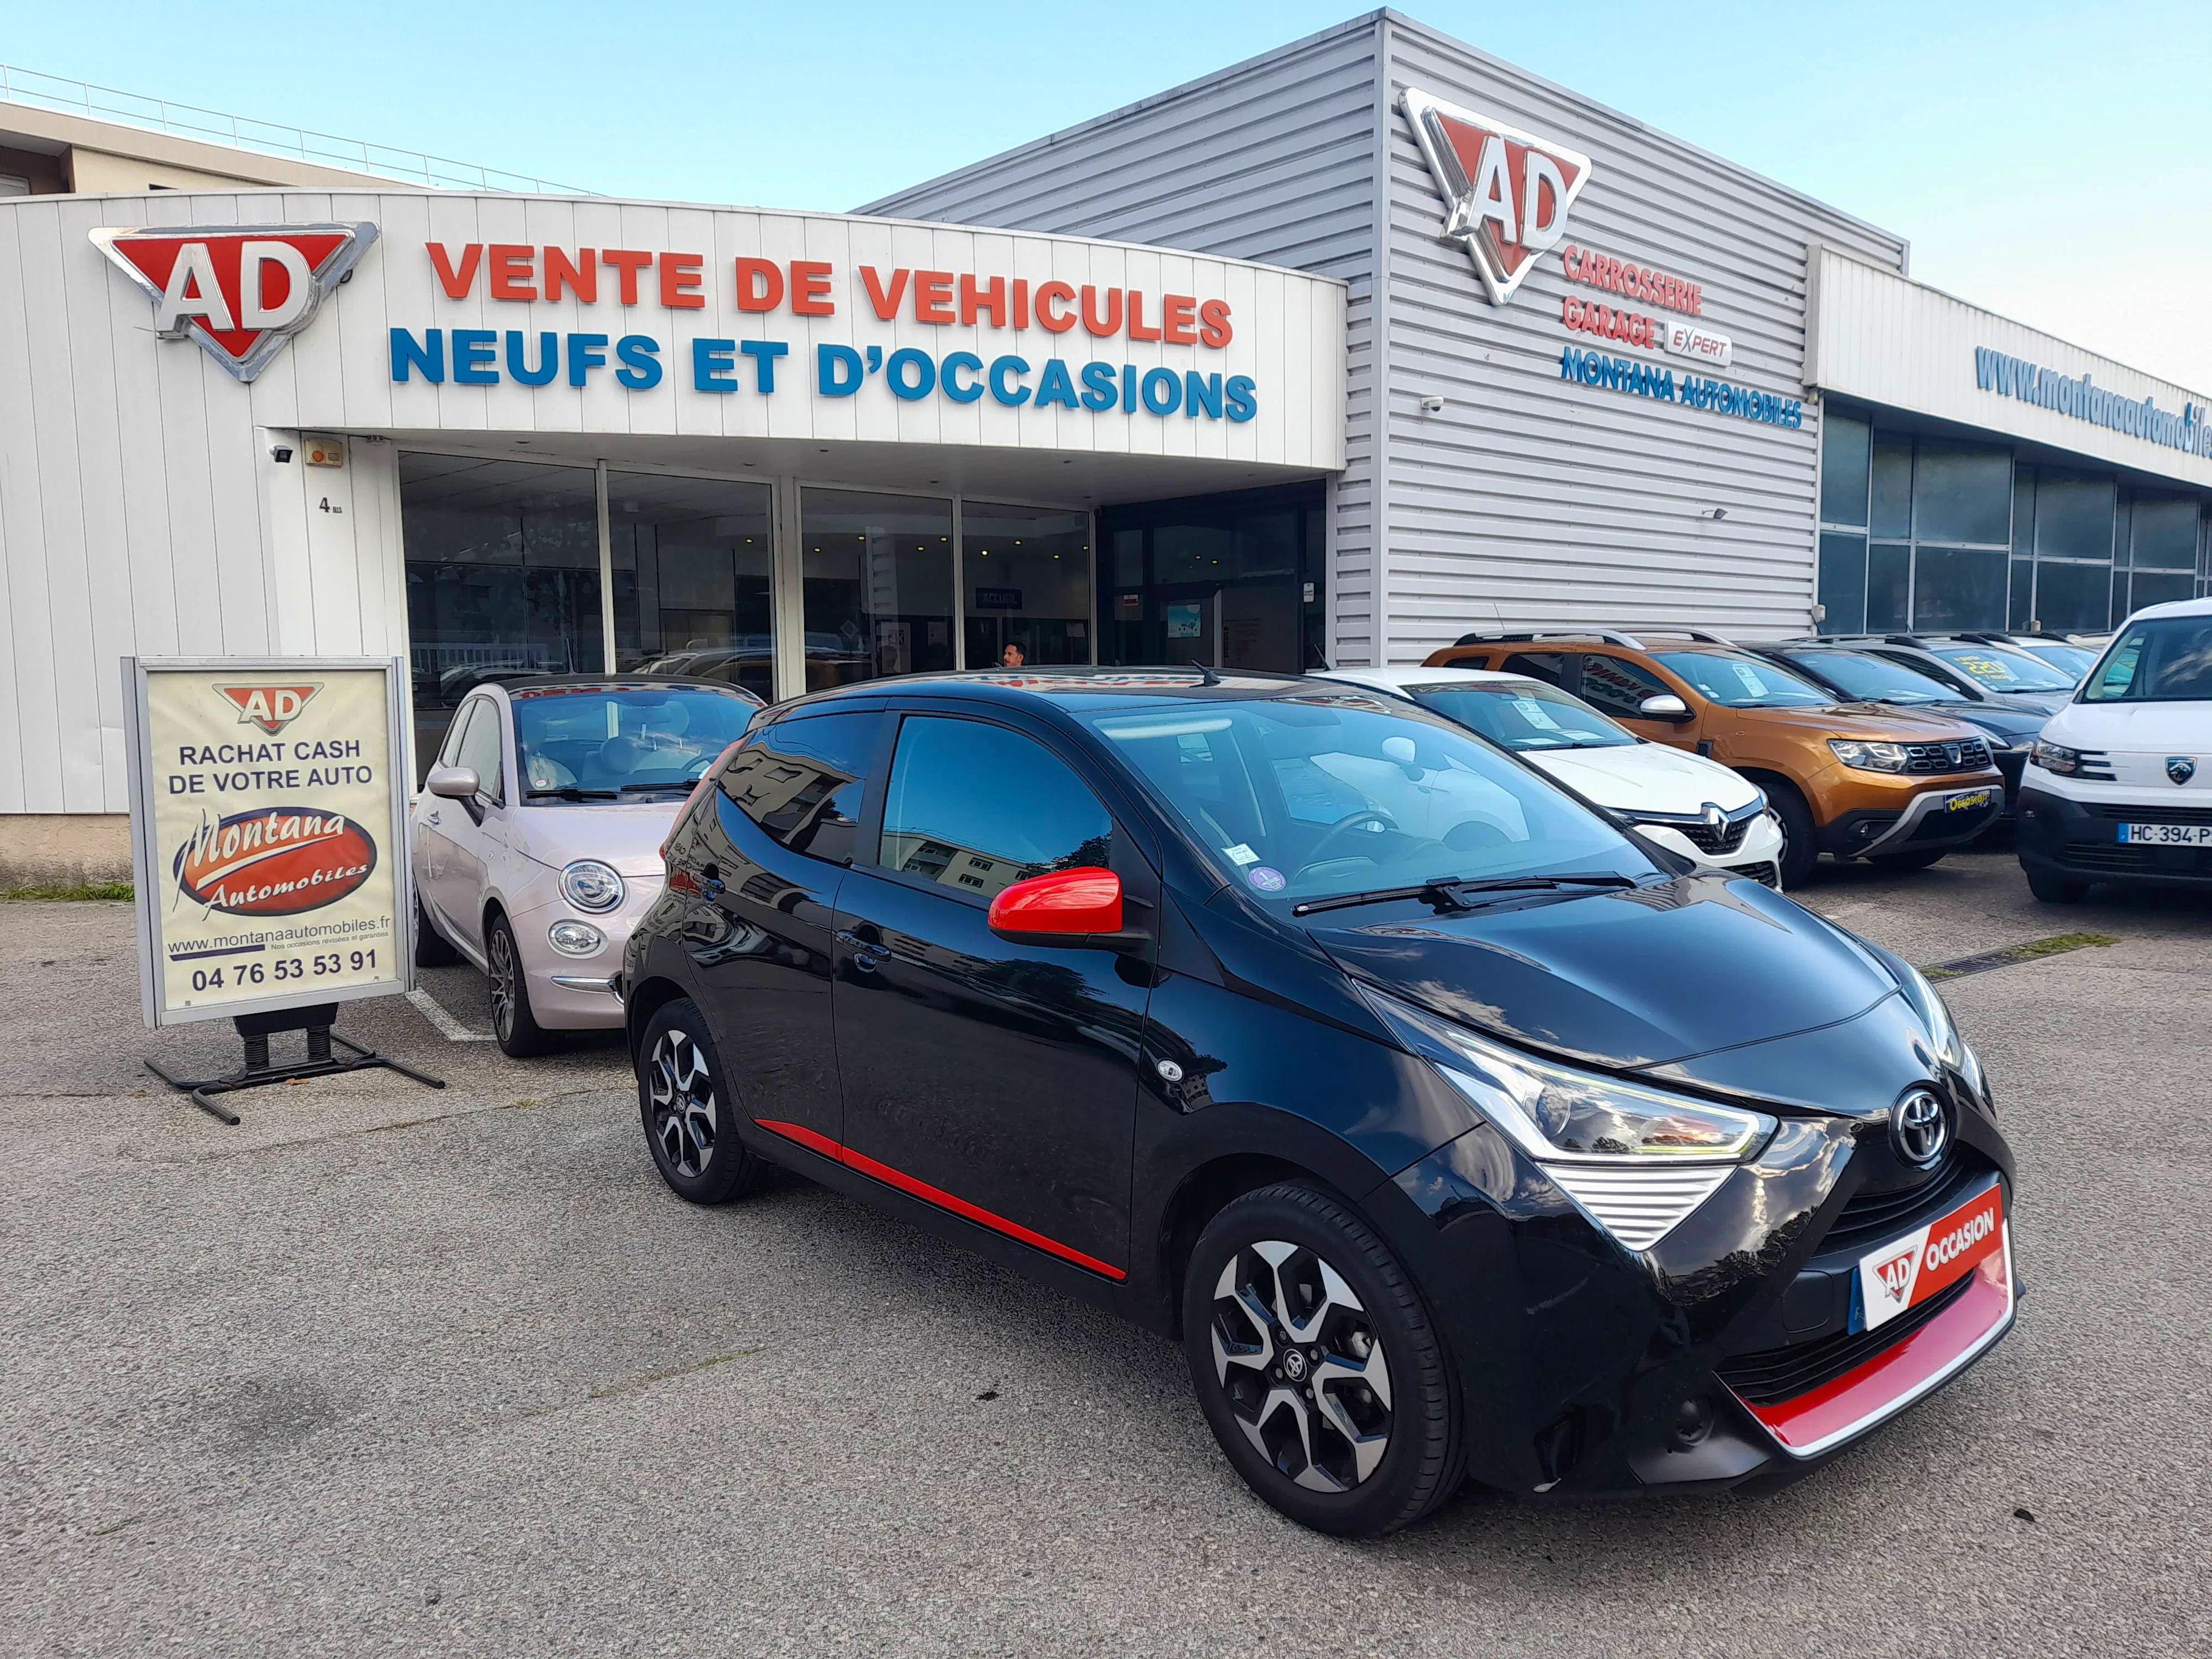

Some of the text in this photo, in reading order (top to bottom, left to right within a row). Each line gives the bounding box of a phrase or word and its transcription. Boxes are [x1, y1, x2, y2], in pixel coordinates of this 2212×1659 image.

[1467, 135, 1568, 250] AD
[156, 240, 315, 332] AD
[425, 242, 1233, 348] VENTE DE VEHICULES
[1563, 244, 1702, 316] CARROSSERIE
[1563, 296, 1655, 349] GARAGE
[1673, 328, 1727, 357] EXPERT
[390, 328, 1257, 423] NEUFS ET D'OCCASIONS
[1560, 346, 1802, 429] MONTANA AUTOMOBILES
[1976, 345, 2212, 460] www.montanaautomobile
[319, 497, 330, 513] 4
[238, 690, 302, 721] AD
[169, 766, 372, 794] DE VOTRE AUTO
[179, 740, 360, 766] RACHAT CASH
[173, 808, 346, 912] Montana
[2131, 825, 2212, 844] HC-394-P
[202, 863, 368, 922] Automobiles
[168, 915, 391, 953] www.montanaautomobiles.fr
[287, 939, 320, 949] occasions
[322, 935, 350, 944] révisées
[359, 931, 389, 941] garanties
[192, 949, 376, 991] 04 76 53 53 91
[1886, 1207, 1995, 1293] AD OCCASION
